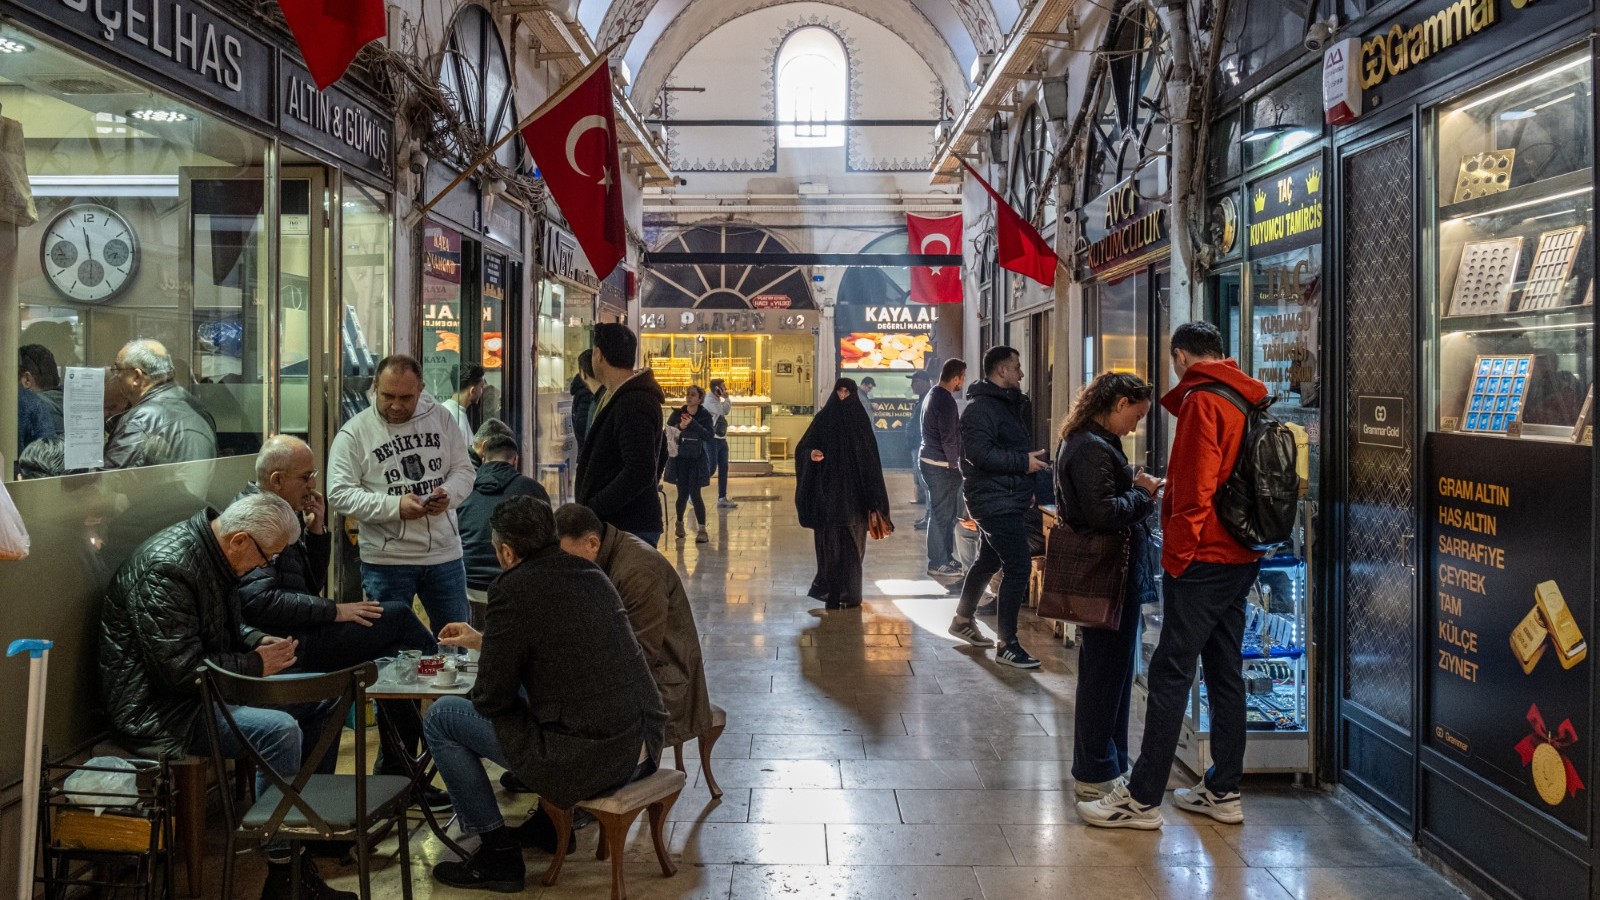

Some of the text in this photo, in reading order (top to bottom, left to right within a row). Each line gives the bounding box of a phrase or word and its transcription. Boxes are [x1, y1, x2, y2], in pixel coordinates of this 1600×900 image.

[64, 0, 241, 92] ÇELHAS
[289, 76, 387, 171] ALTIN & GÜMÜŞ
[1278, 176, 1292, 206] TAÇ
[84, 213, 95, 223] 12
[1250, 216, 1284, 246] KUYUMCU
[1088, 209, 1160, 268] KUYUMCULUK
[865, 306, 913, 321] KAYA
[877, 322, 906, 330] DEĞERLİ
[1261, 311, 1310, 336] KUYUMCU
[877, 402, 896, 411] AYA
[1364, 424, 1400, 437] Grammar Gold
[384, 458, 442, 484] 19 03
[1439, 477, 1509, 507] GRAM ALTIN
[1439, 506, 1497, 536] HAS ALTIN
[1439, 564, 1486, 595] ÇEYREK
[1439, 592, 1462, 617] TAM
[1439, 620, 1478, 654] KÜLÇE
